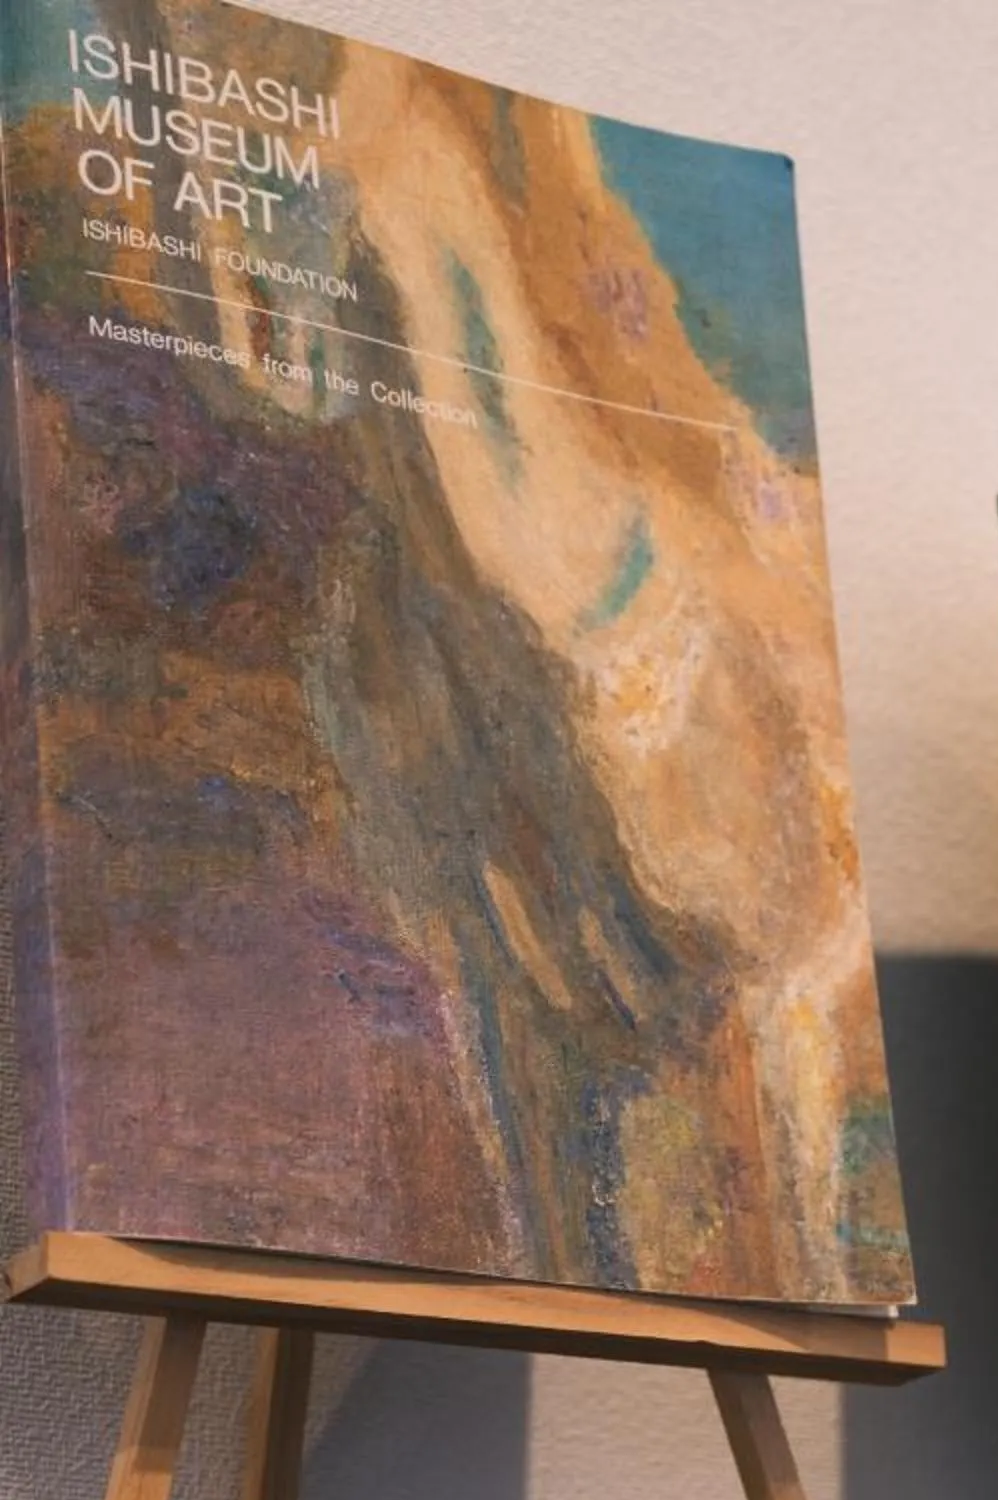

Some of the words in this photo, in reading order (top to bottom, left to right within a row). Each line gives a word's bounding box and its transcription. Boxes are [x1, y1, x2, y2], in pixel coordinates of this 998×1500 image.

[68, 29, 340, 140] ISHIBASHI
[73, 88, 320, 189] MUSEUM
[78, 149, 155, 200] OF
[173, 170, 283, 233] ART
[82, 217, 201, 262] ISHIBASHI
[214, 248, 358, 302] FOUNDATION
[89, 315, 251, 370] Masterpieces
[262, 352, 313, 384] from
[324, 368, 360, 397] the
[371, 380, 478, 429] Collection
